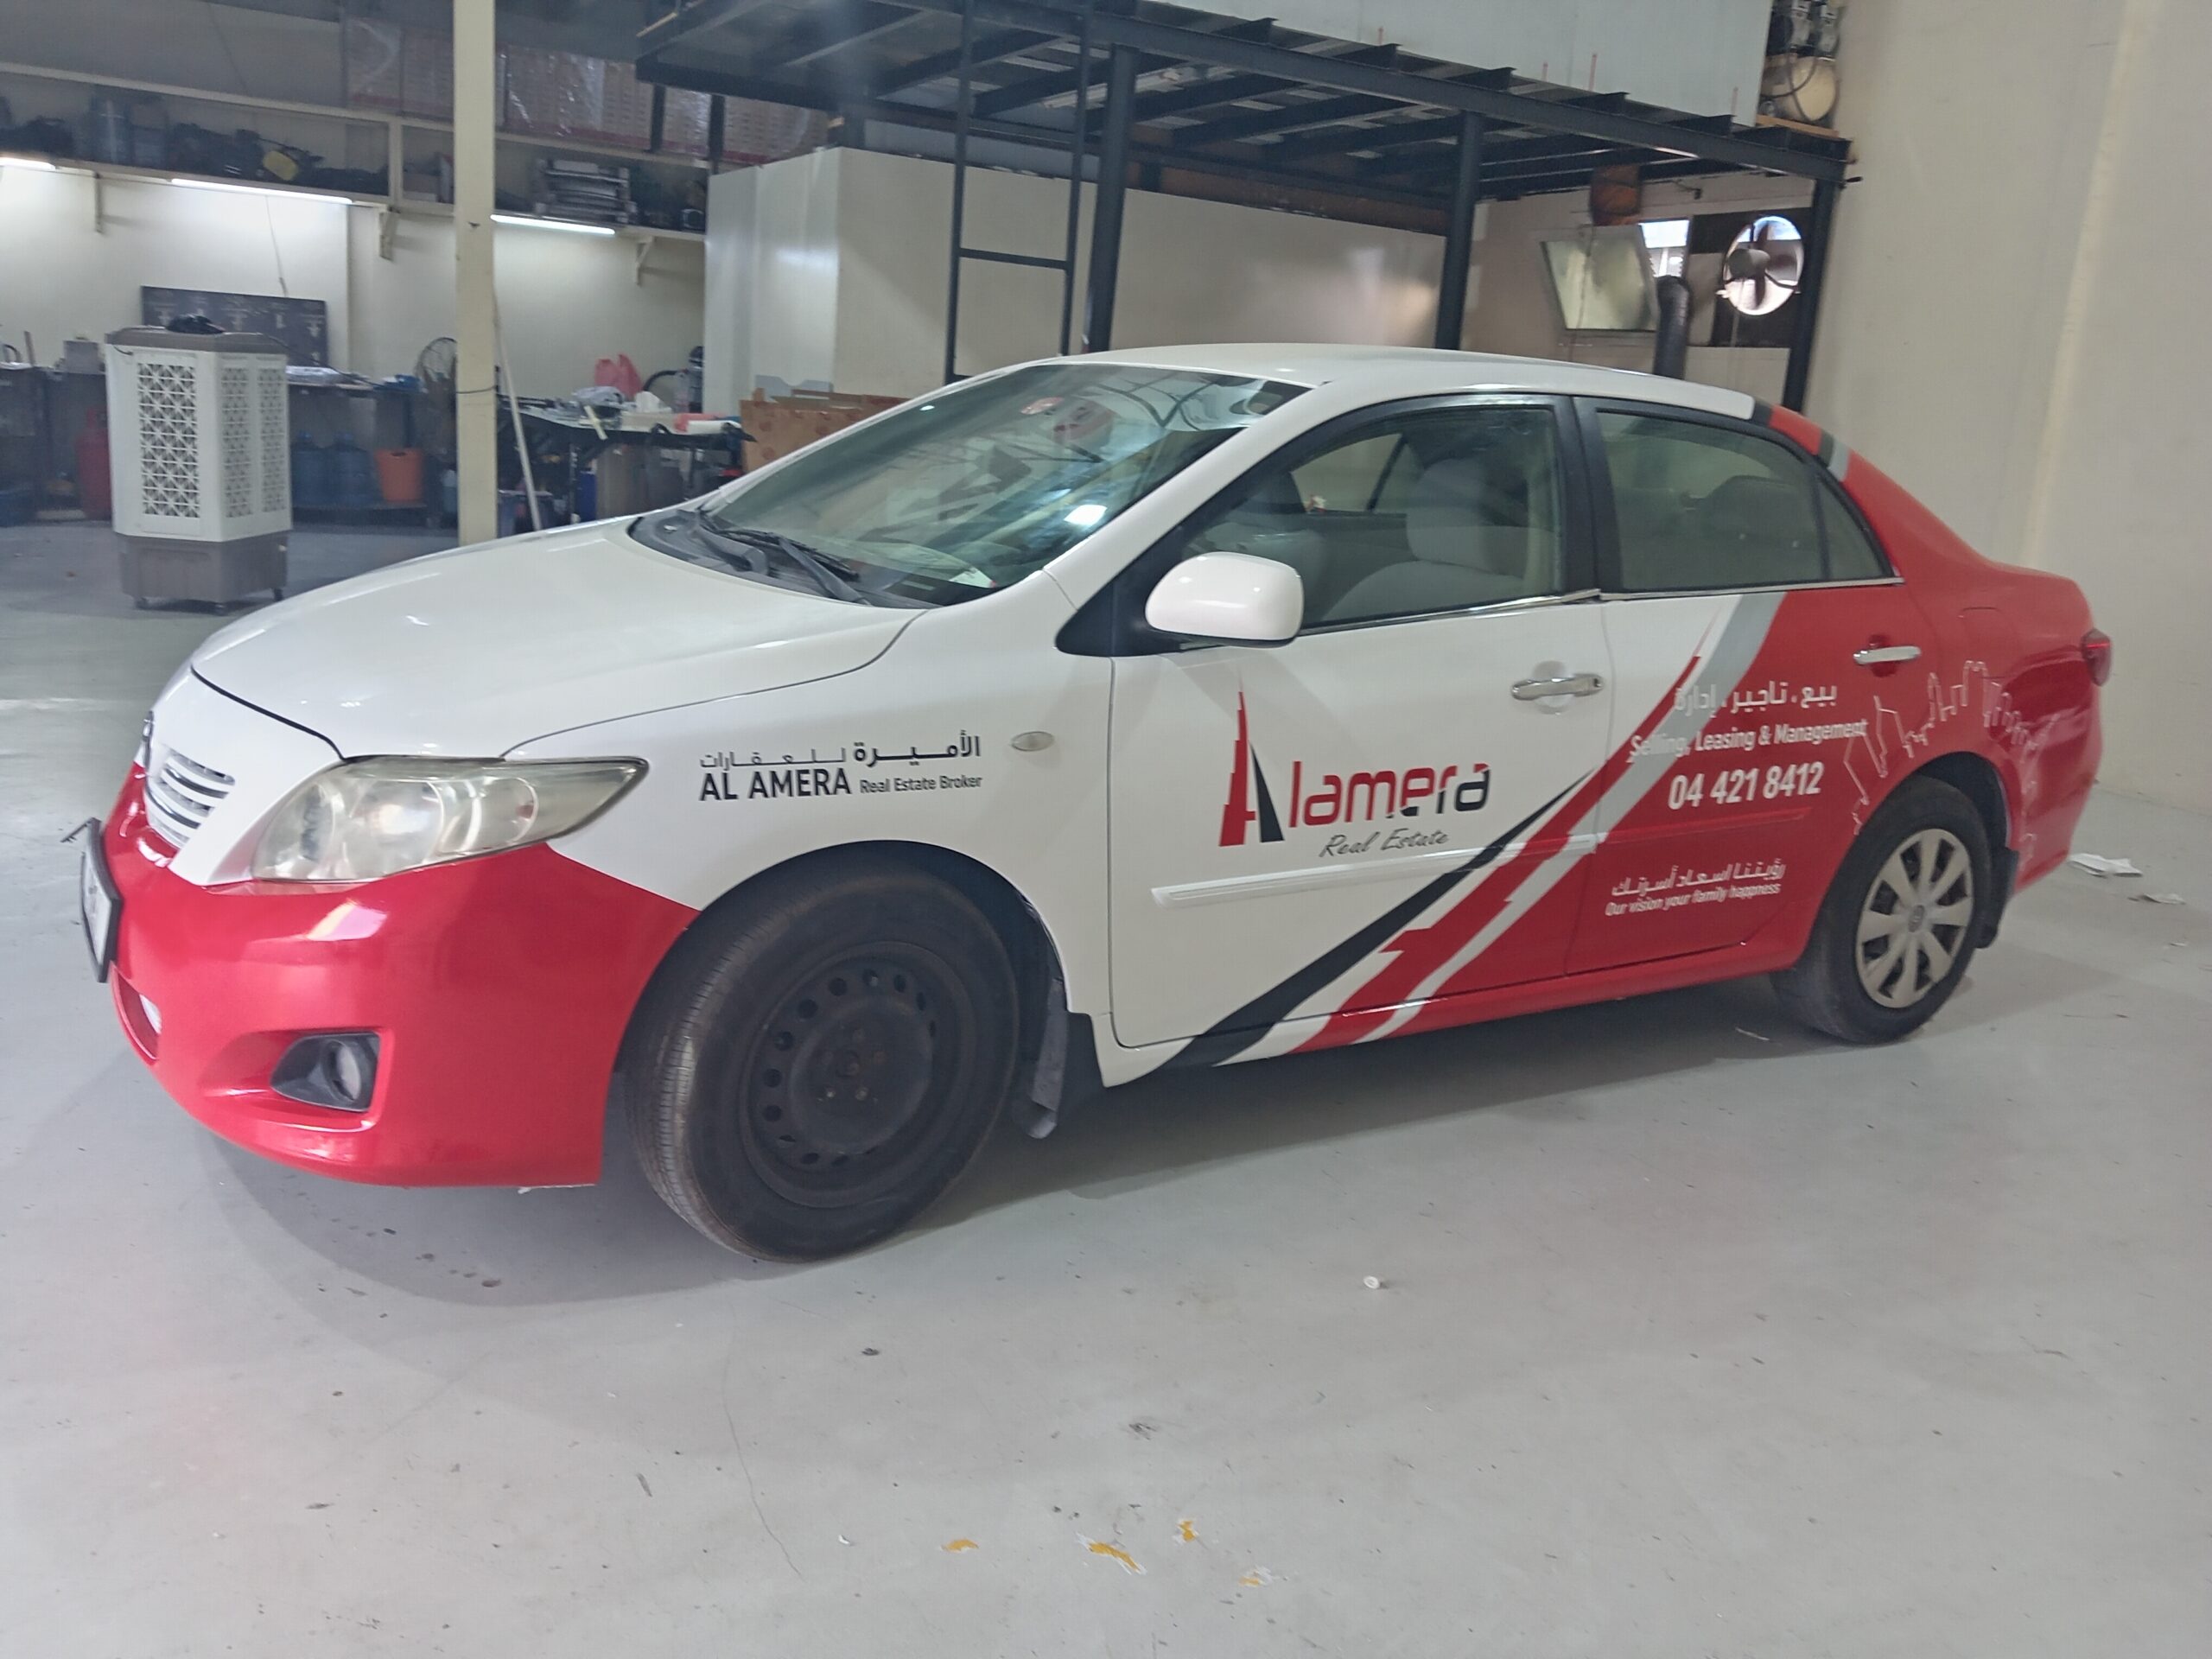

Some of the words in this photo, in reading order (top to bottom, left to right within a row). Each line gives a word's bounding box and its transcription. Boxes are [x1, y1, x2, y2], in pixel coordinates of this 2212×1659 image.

[1801, 685, 1838, 709] بيع
[854, 730, 981, 767] الأميرة
[1694, 727, 1756, 751] Leasing
[1758, 725, 1771, 746] &
[1773, 719, 1869, 745] Management
[700, 747, 847, 771] للعقارات
[1219, 687, 1491, 847] Alamera
[699, 772, 739, 801] AL
[747, 767, 852, 798] AMERA
[860, 778, 891, 793] Real
[893, 777, 937, 791] Estate
[939, 775, 982, 790] Broker
[1668, 773, 1706, 810] 04
[1709, 767, 1760, 804] 421
[1762, 761, 1825, 799] 8412
[1318, 830, 1381, 858] Real
[1380, 827, 1451, 851] Estate
[1605, 902, 1628, 916] Our
[1629, 896, 1663, 912] vision
[1662, 893, 1691, 911] your
[1691, 886, 1728, 902] family
